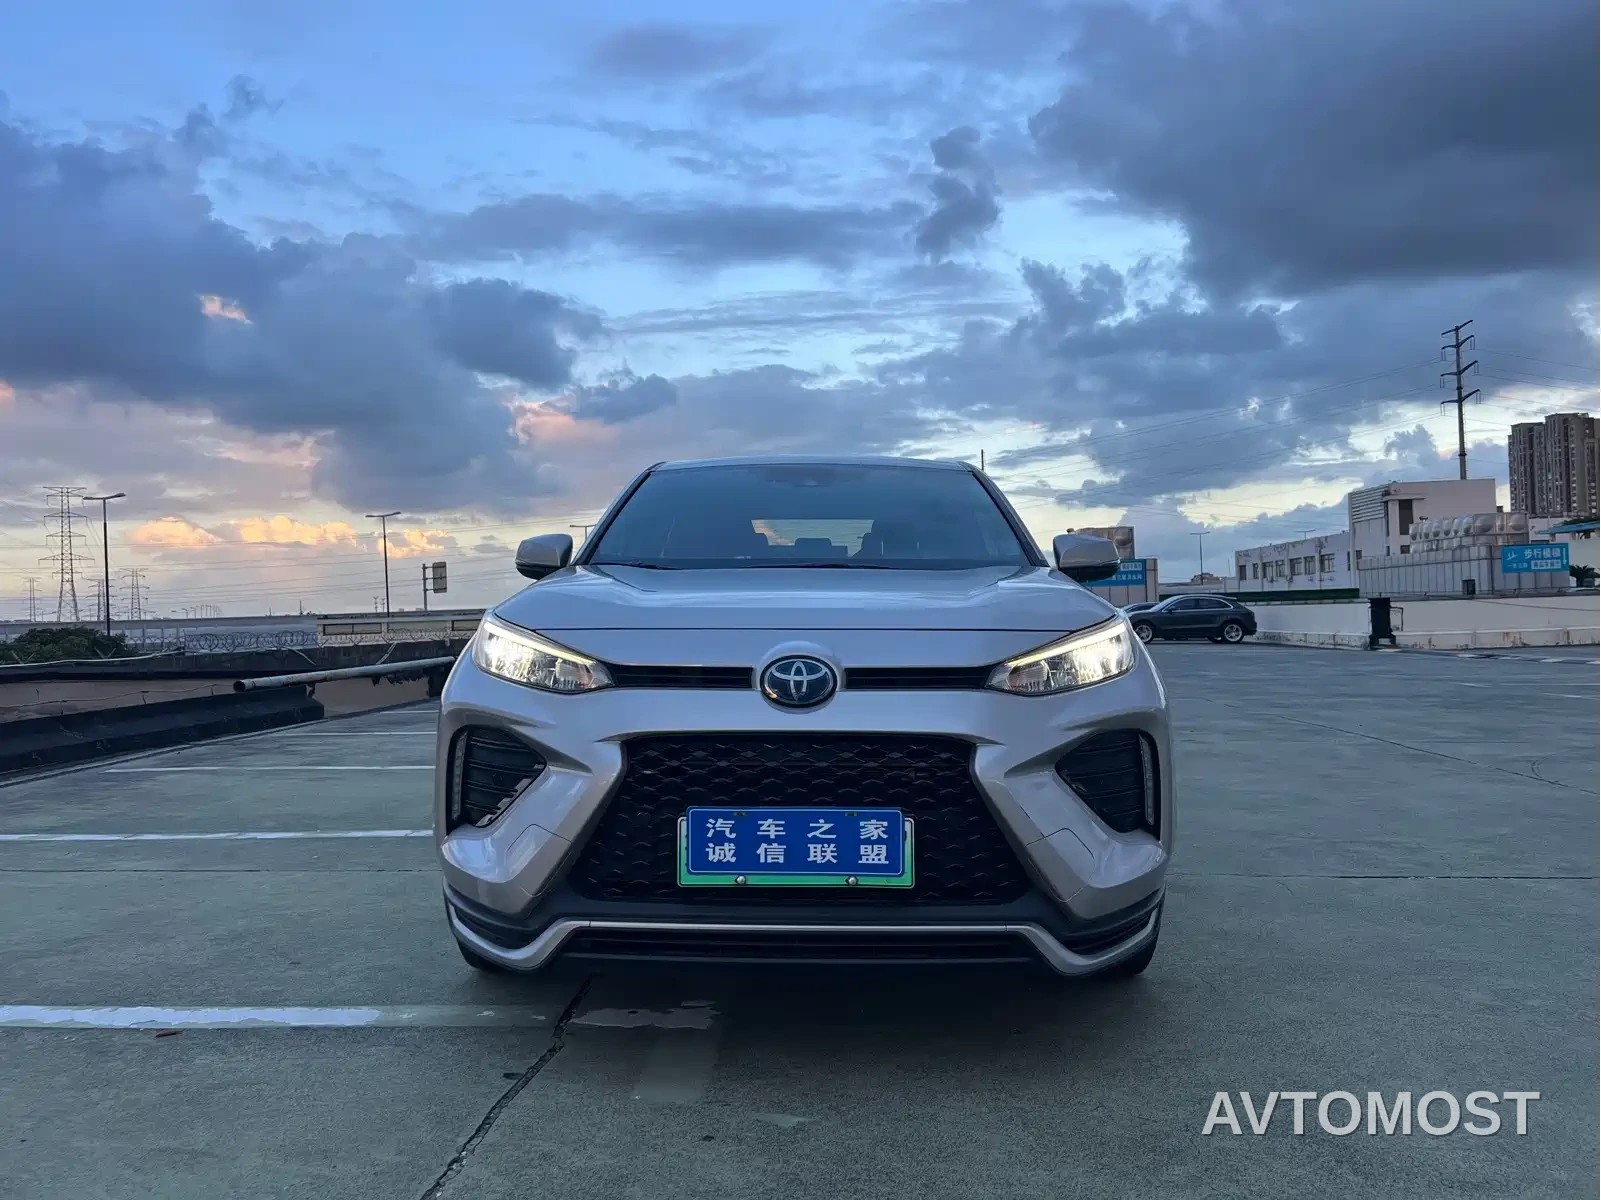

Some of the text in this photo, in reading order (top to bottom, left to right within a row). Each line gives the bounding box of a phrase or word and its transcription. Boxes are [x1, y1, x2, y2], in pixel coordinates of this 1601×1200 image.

[706, 818, 889, 840] 汽车之家
[705, 842, 889, 864] 诚信联盟
